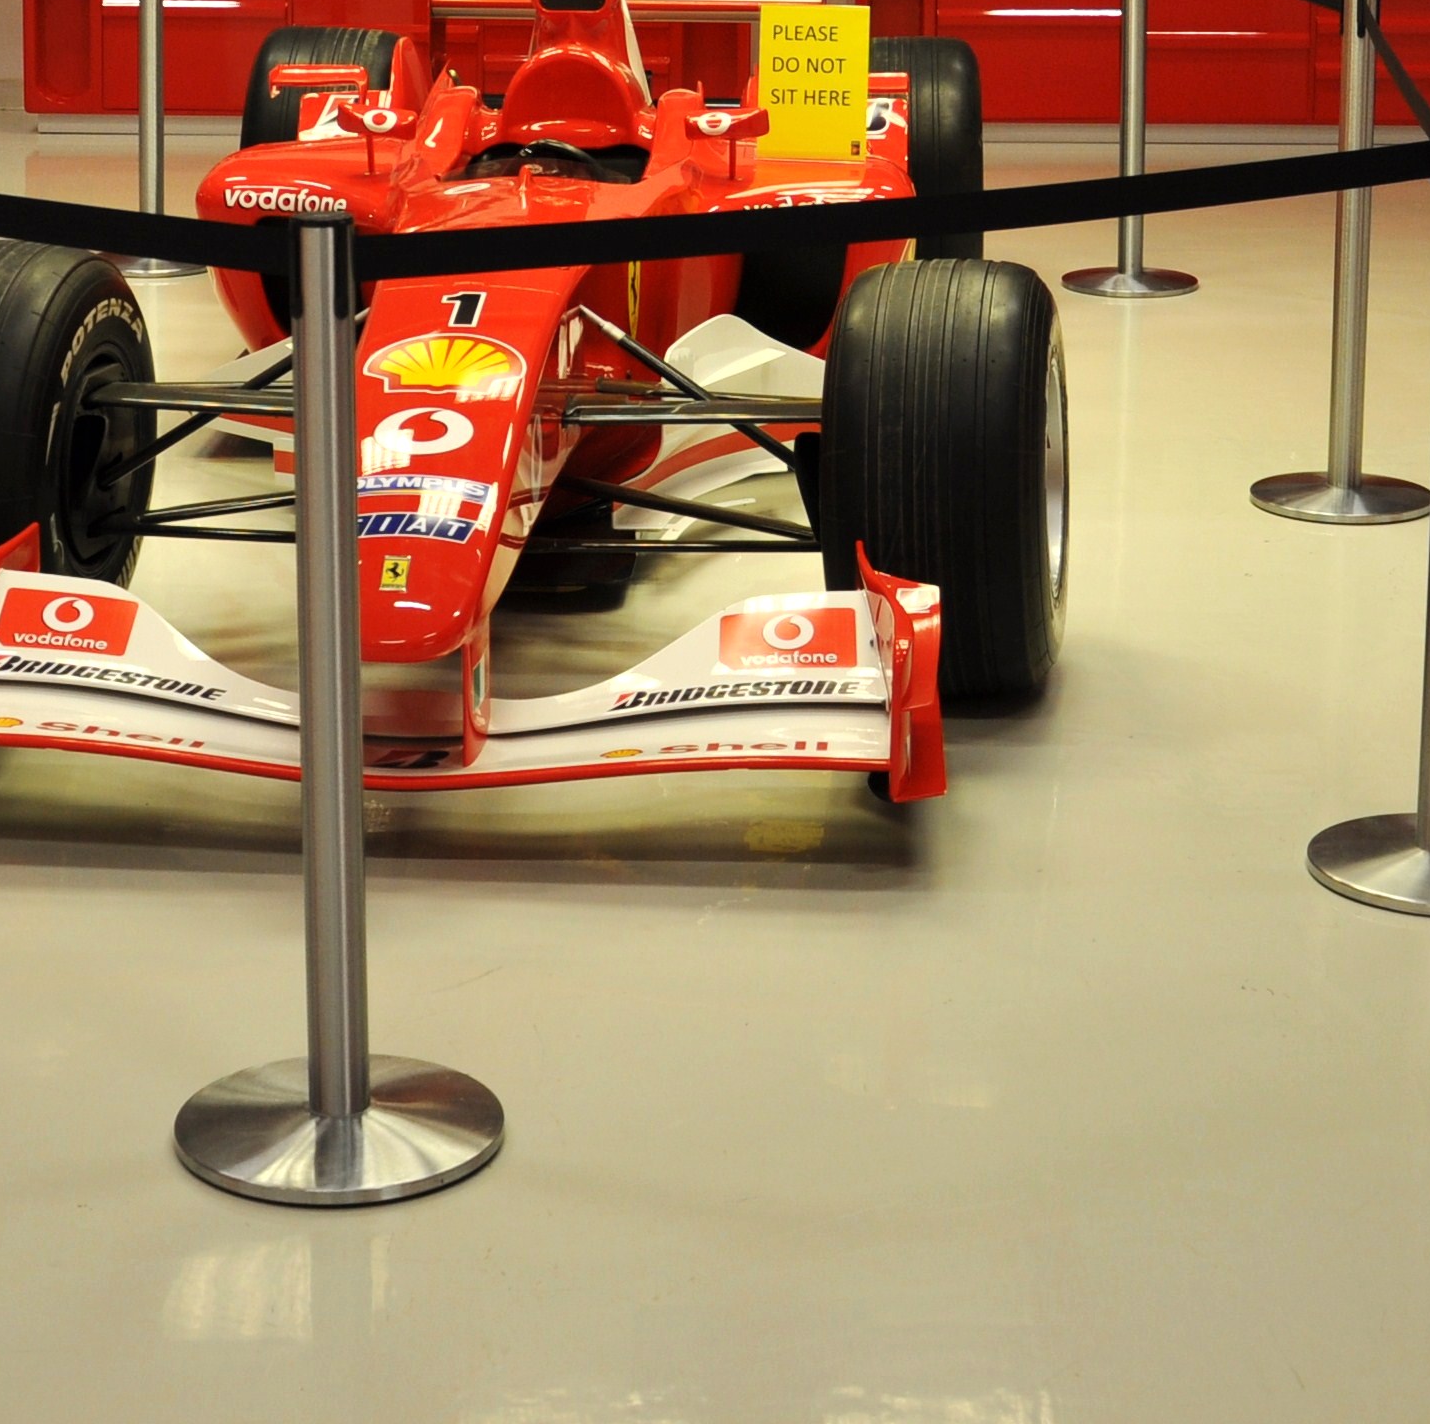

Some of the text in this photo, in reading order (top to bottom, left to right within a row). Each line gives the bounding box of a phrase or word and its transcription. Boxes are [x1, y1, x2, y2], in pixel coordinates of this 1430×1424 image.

[773, 25, 839, 42] PLEASE
[772, 56, 847, 74] DO NOT
[770, 88, 851, 107] SIT HERE
[224, 186, 347, 213] vodafone
[442, 292, 487, 327] 1
[60, 297, 143, 389] POTENZA
[358, 516, 467, 537] IAT
[13, 631, 108, 651] vodafone
[740, 651, 838, 667] vodafone
[607, 680, 860, 712] BRIDGESTONE
